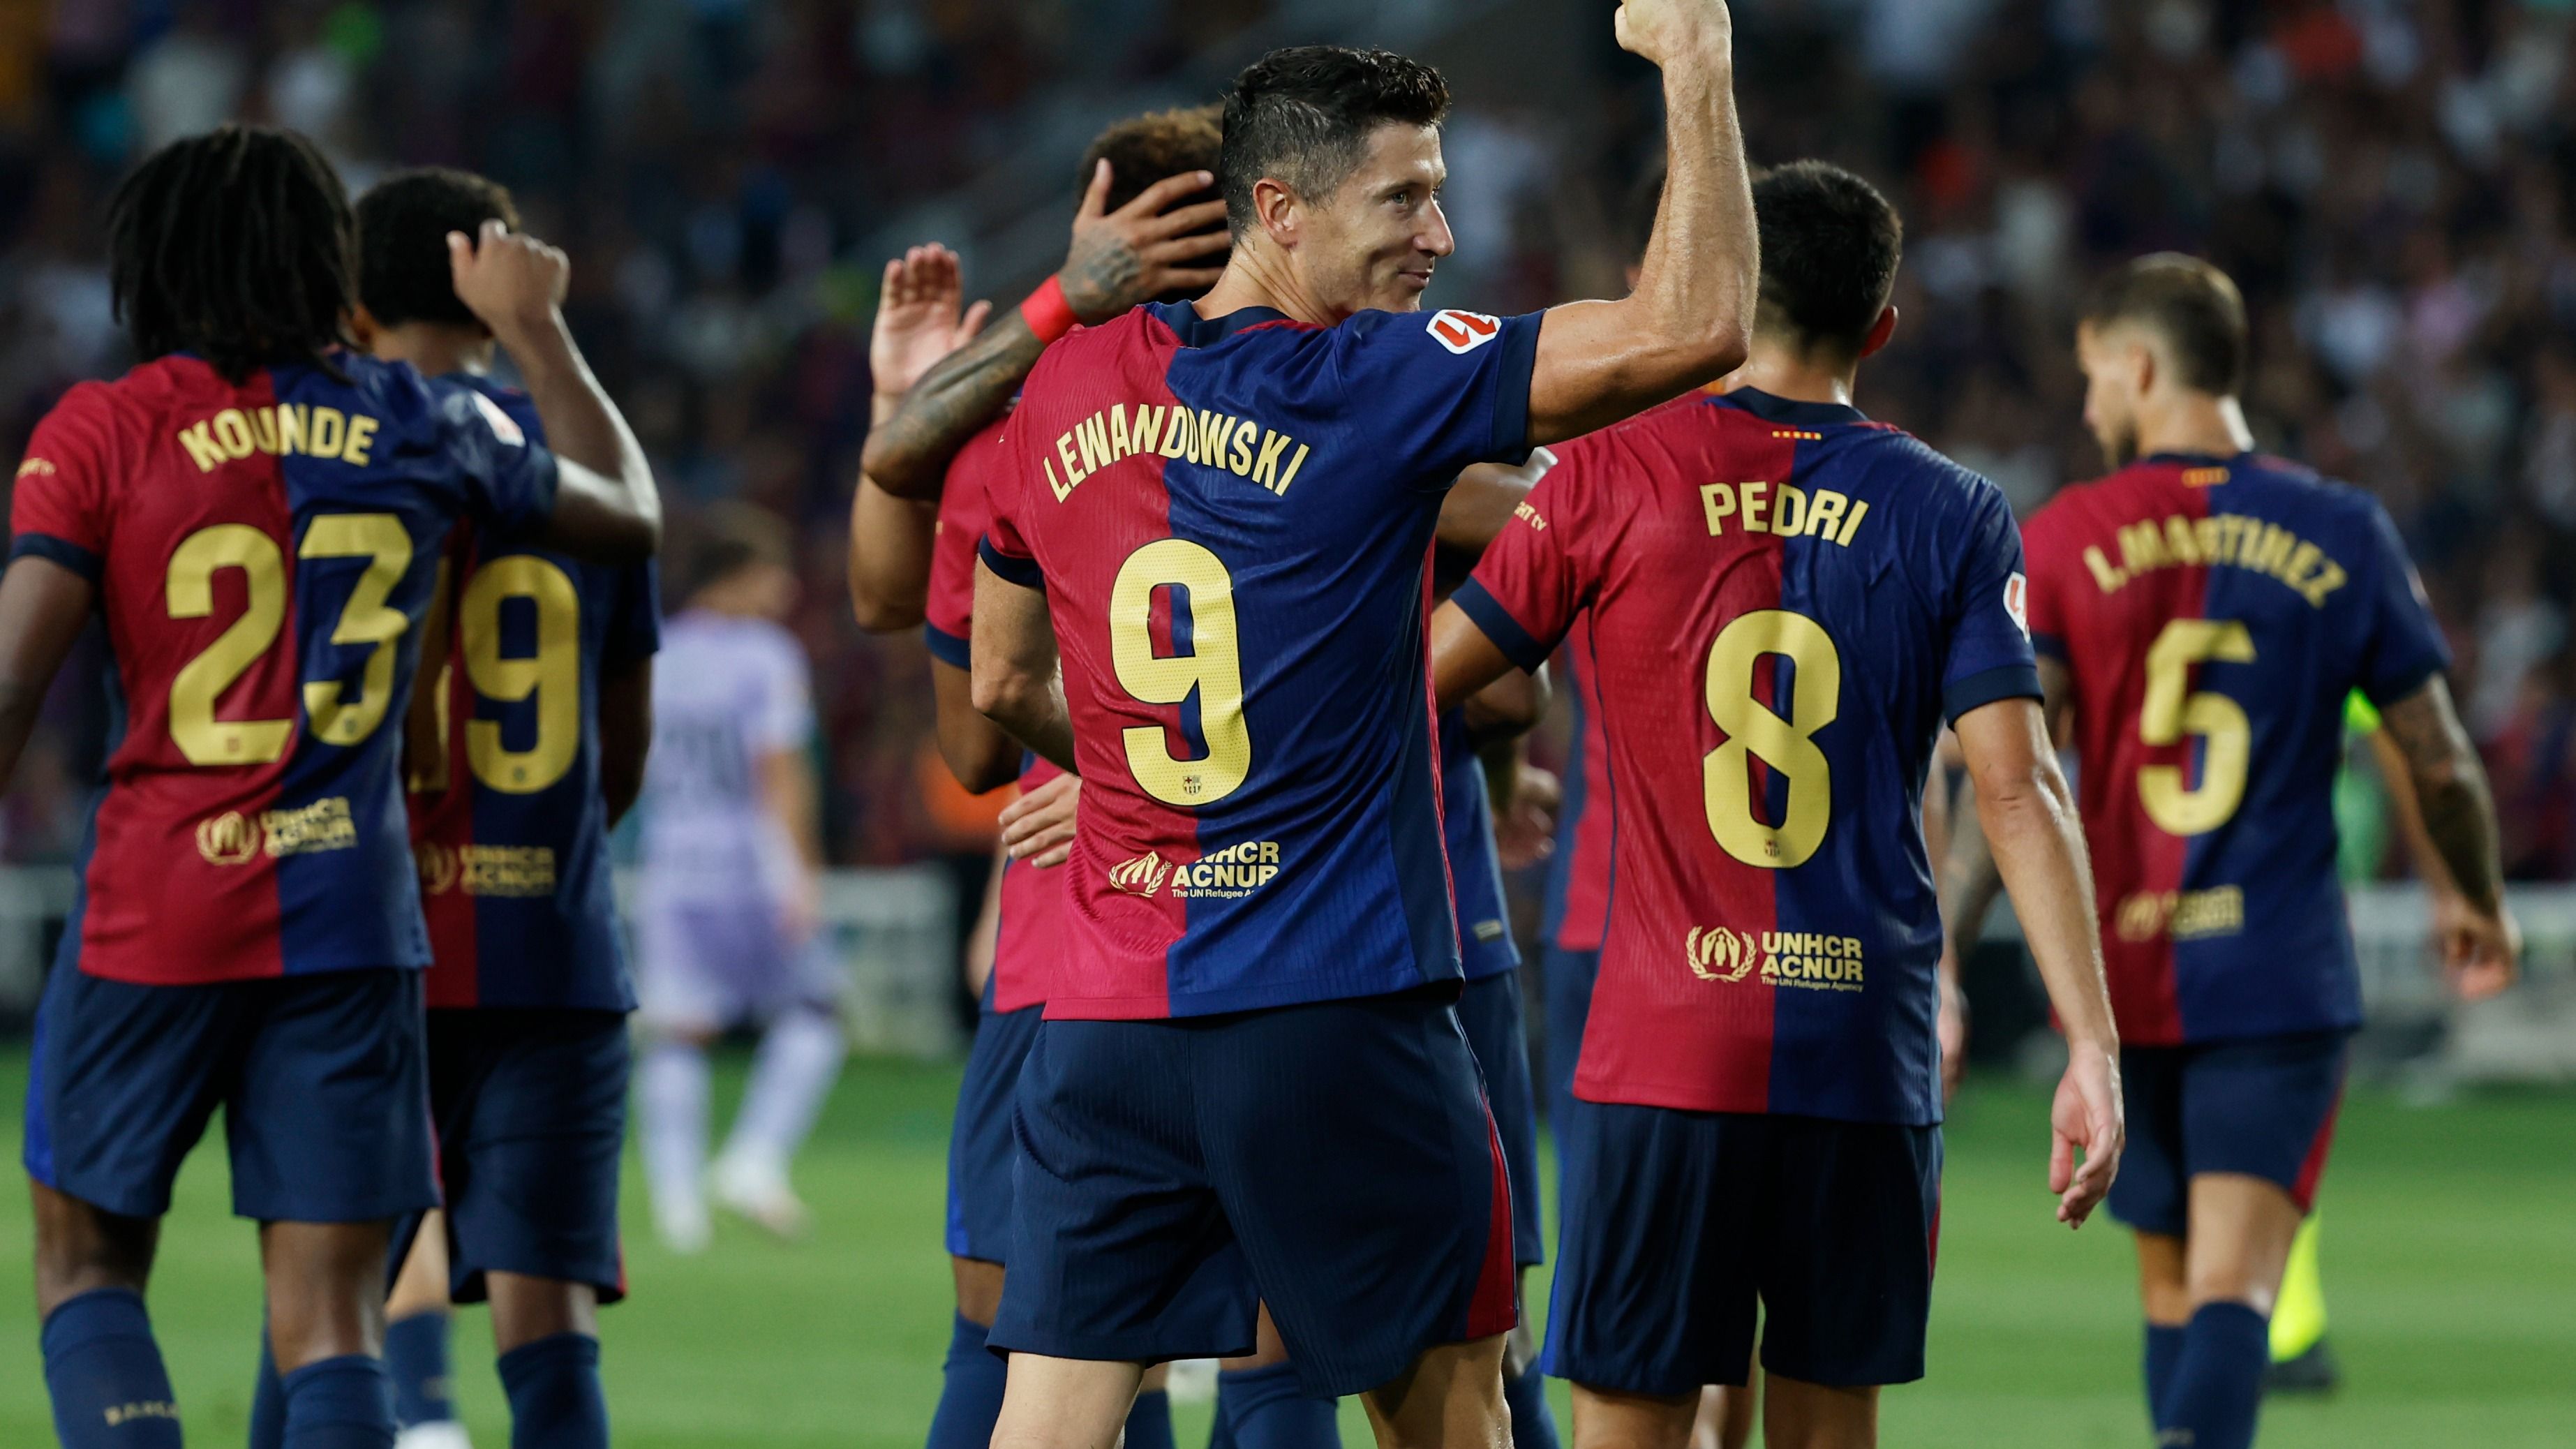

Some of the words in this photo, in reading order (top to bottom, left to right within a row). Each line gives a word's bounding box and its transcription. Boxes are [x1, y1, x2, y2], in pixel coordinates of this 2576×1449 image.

[178, 403, 378, 473] KOUNDE
[1043, 403, 1309, 503] LEWANDOWSKI
[1699, 481, 1869, 547] PEDRI
[165, 513, 412, 766] 23
[1109, 539, 1251, 806] 9
[1703, 609, 1840, 868] 8
[2137, 618, 2254, 835] 5
[1172, 889, 1188, 898] The
[1190, 889, 1204, 898] UN
[1205, 889, 1243, 899] Refugee
[1759, 954, 1863, 981] ACNUR
[1762, 931, 1863, 960] UNHCR
